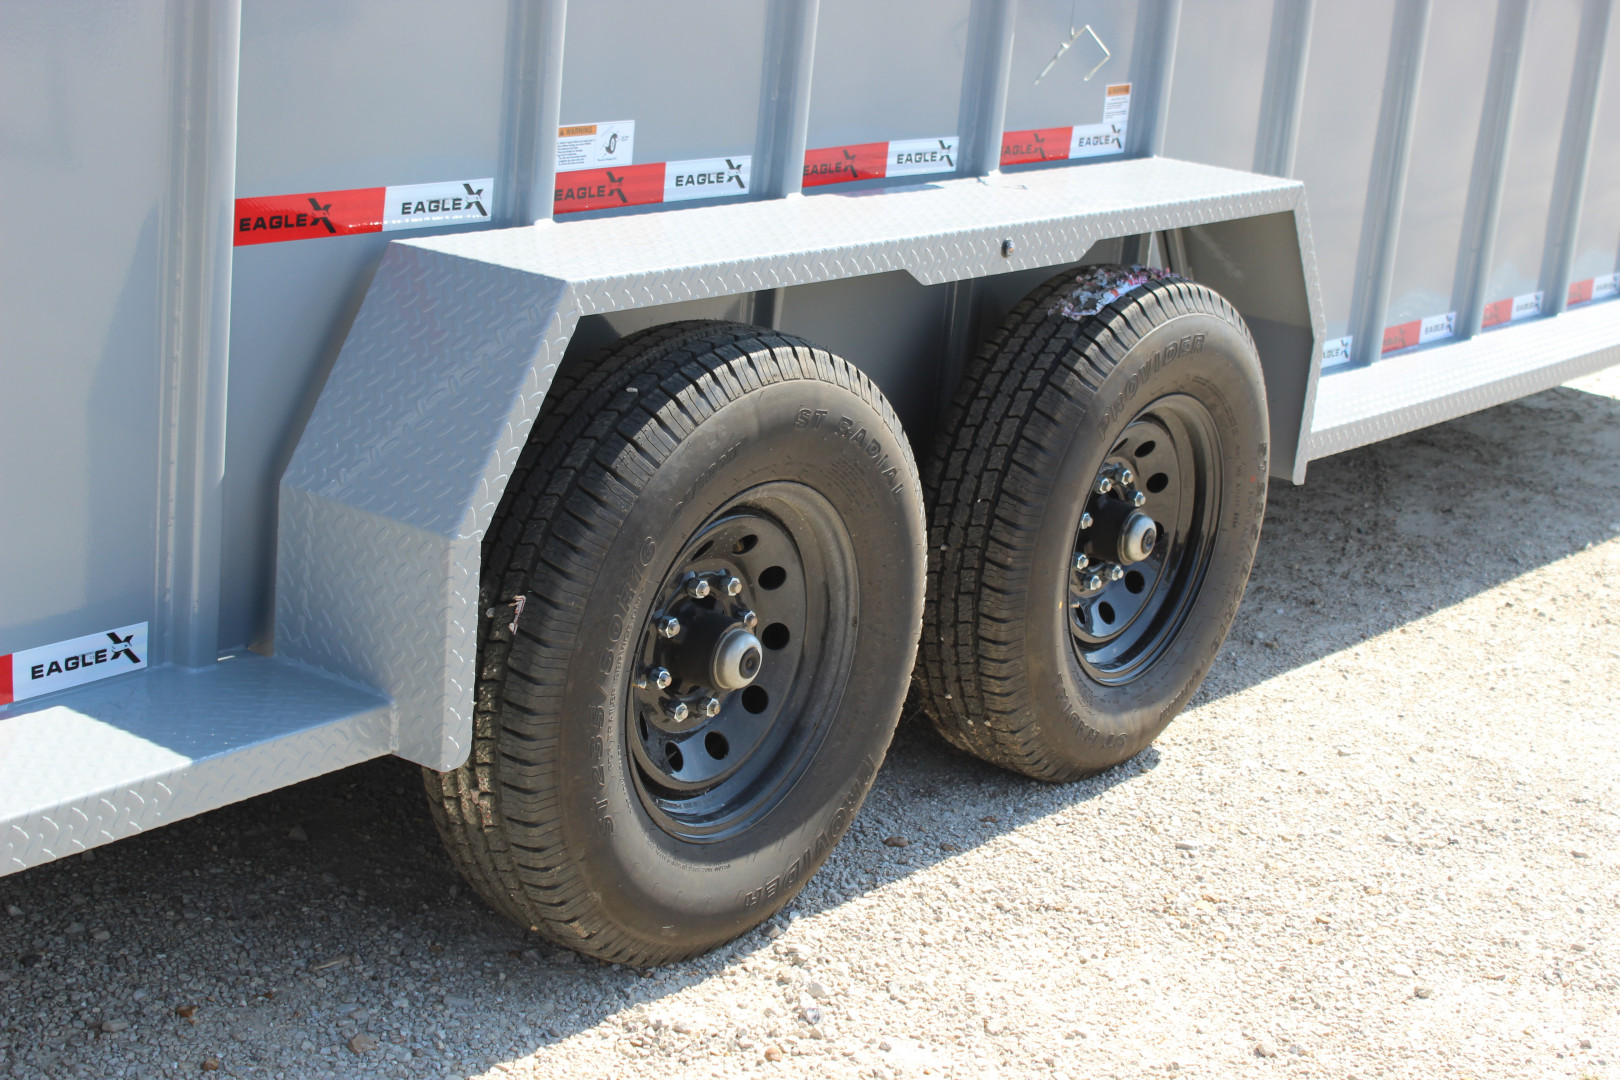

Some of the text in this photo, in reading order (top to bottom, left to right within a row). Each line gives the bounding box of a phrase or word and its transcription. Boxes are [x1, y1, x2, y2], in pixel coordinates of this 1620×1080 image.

[566, 127, 593, 136] WARNING
[1098, 334, 1205, 442] PROVIDER
[793, 408, 828, 429] ST
[838, 415, 904, 503] RADIAL
[607, 687, 617, 742] TRAILER
[593, 797, 614, 837] ST
[744, 754, 876, 910] PROVIDER
